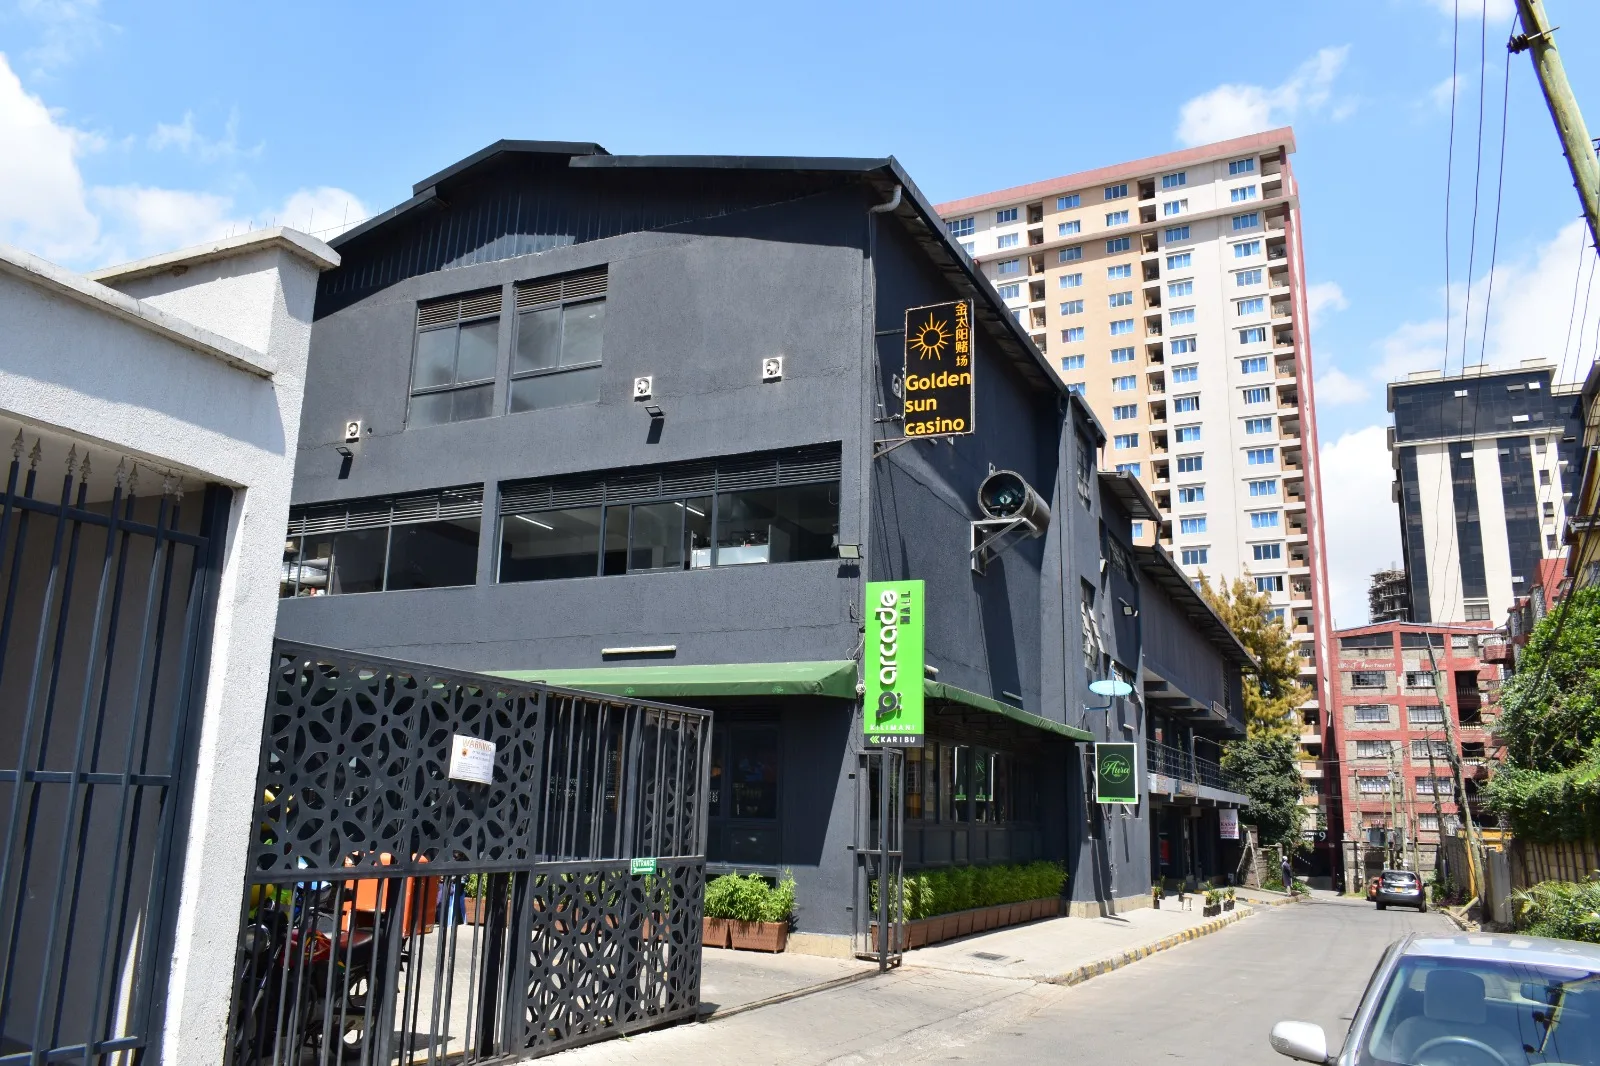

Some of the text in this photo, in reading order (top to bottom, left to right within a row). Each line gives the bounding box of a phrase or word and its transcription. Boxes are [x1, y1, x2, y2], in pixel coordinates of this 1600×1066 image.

[955, 302, 968, 367] 金太阳赌场
[905, 371, 971, 391] Golden
[905, 398, 937, 413] sun
[905, 417, 965, 436] casino
[875, 589, 898, 685] arcade
